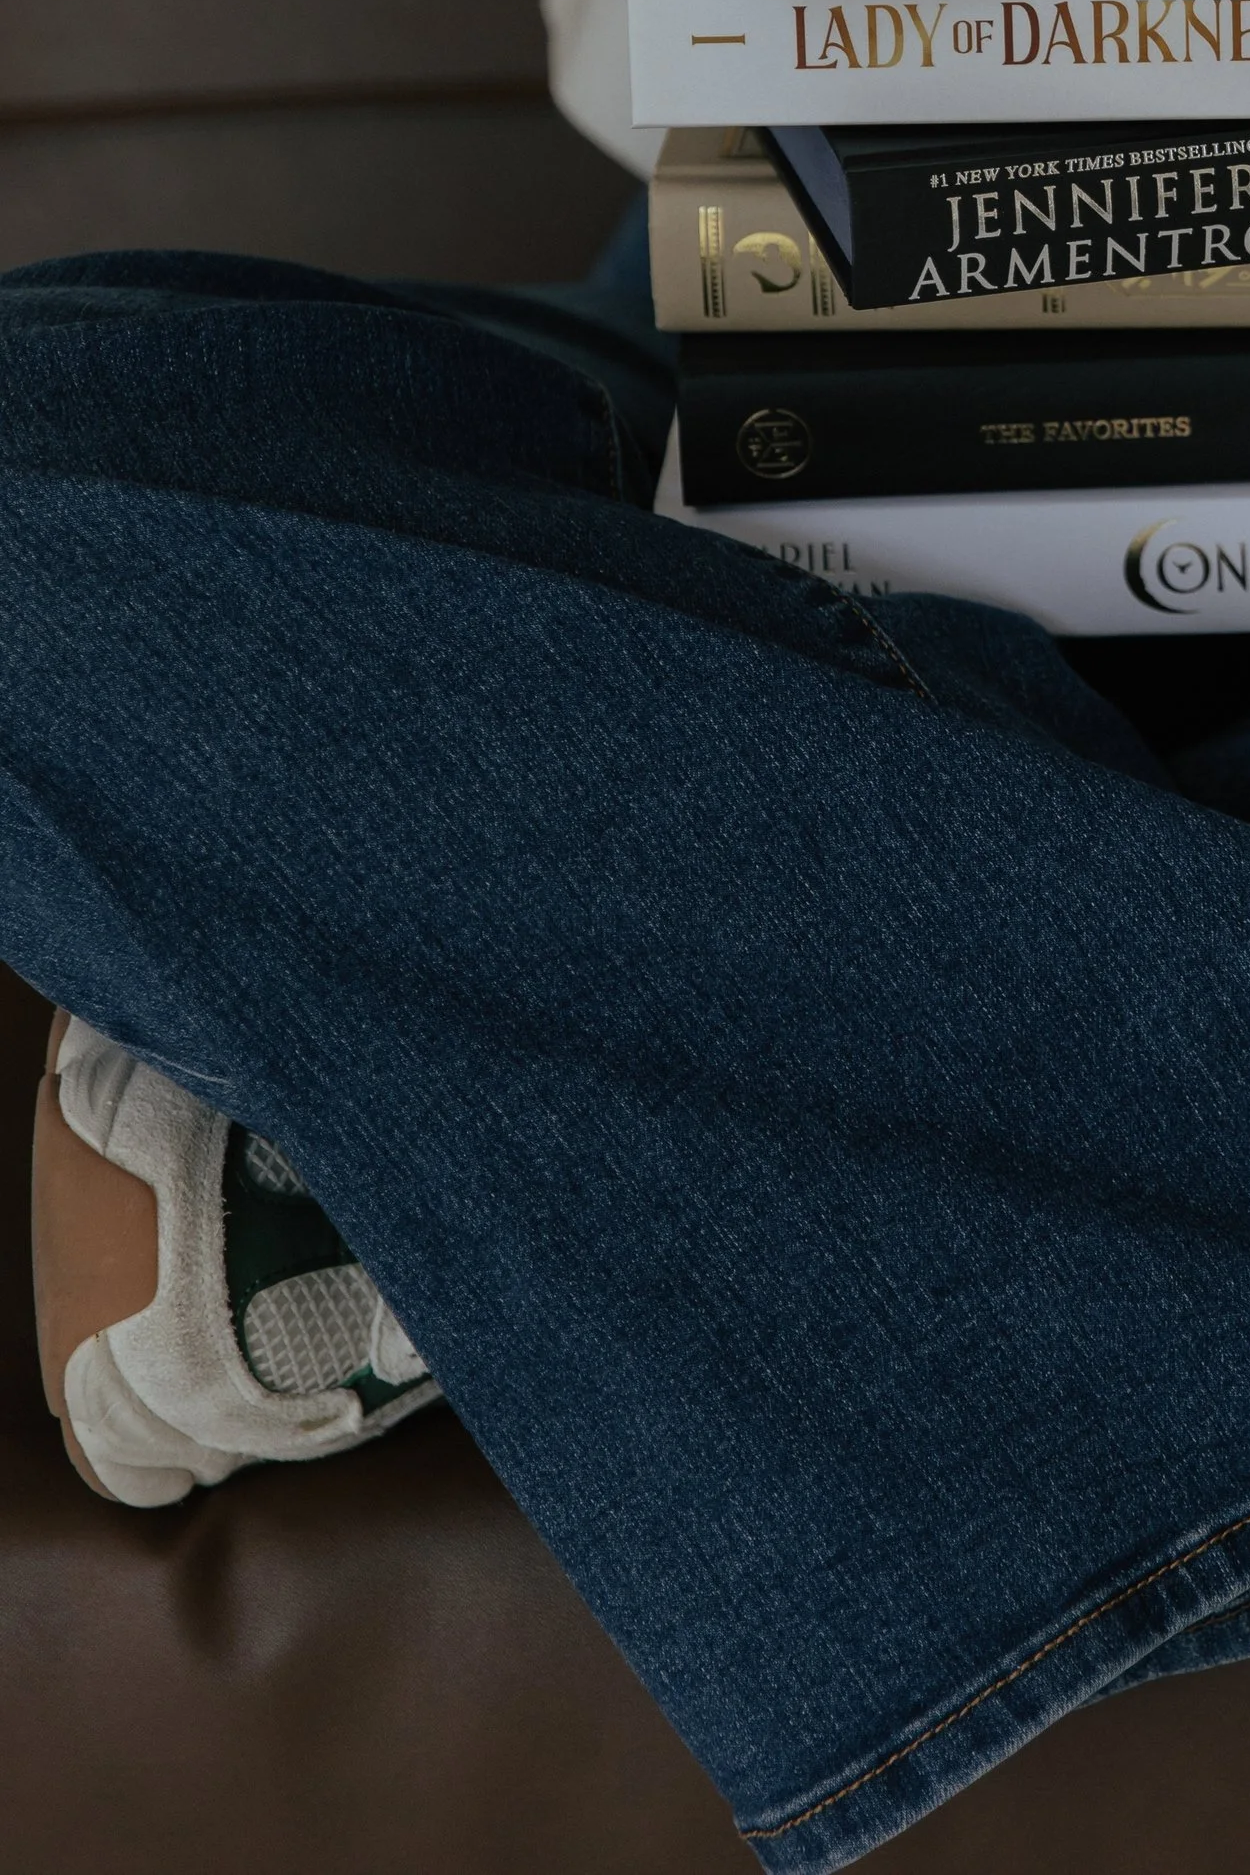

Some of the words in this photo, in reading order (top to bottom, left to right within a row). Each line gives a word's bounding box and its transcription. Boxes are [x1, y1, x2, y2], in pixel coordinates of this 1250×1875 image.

[791, 2, 949, 70] LADY
[952, 19, 994, 55] OF
[929, 172, 949, 189] #1
[954, 166, 1001, 186] NEW
[1004, 160, 1061, 180] YORK
[1064, 152, 1125, 174] TIMES
[980, 423, 1035, 445] THE
[1043, 415, 1193, 442] FAVORITES
